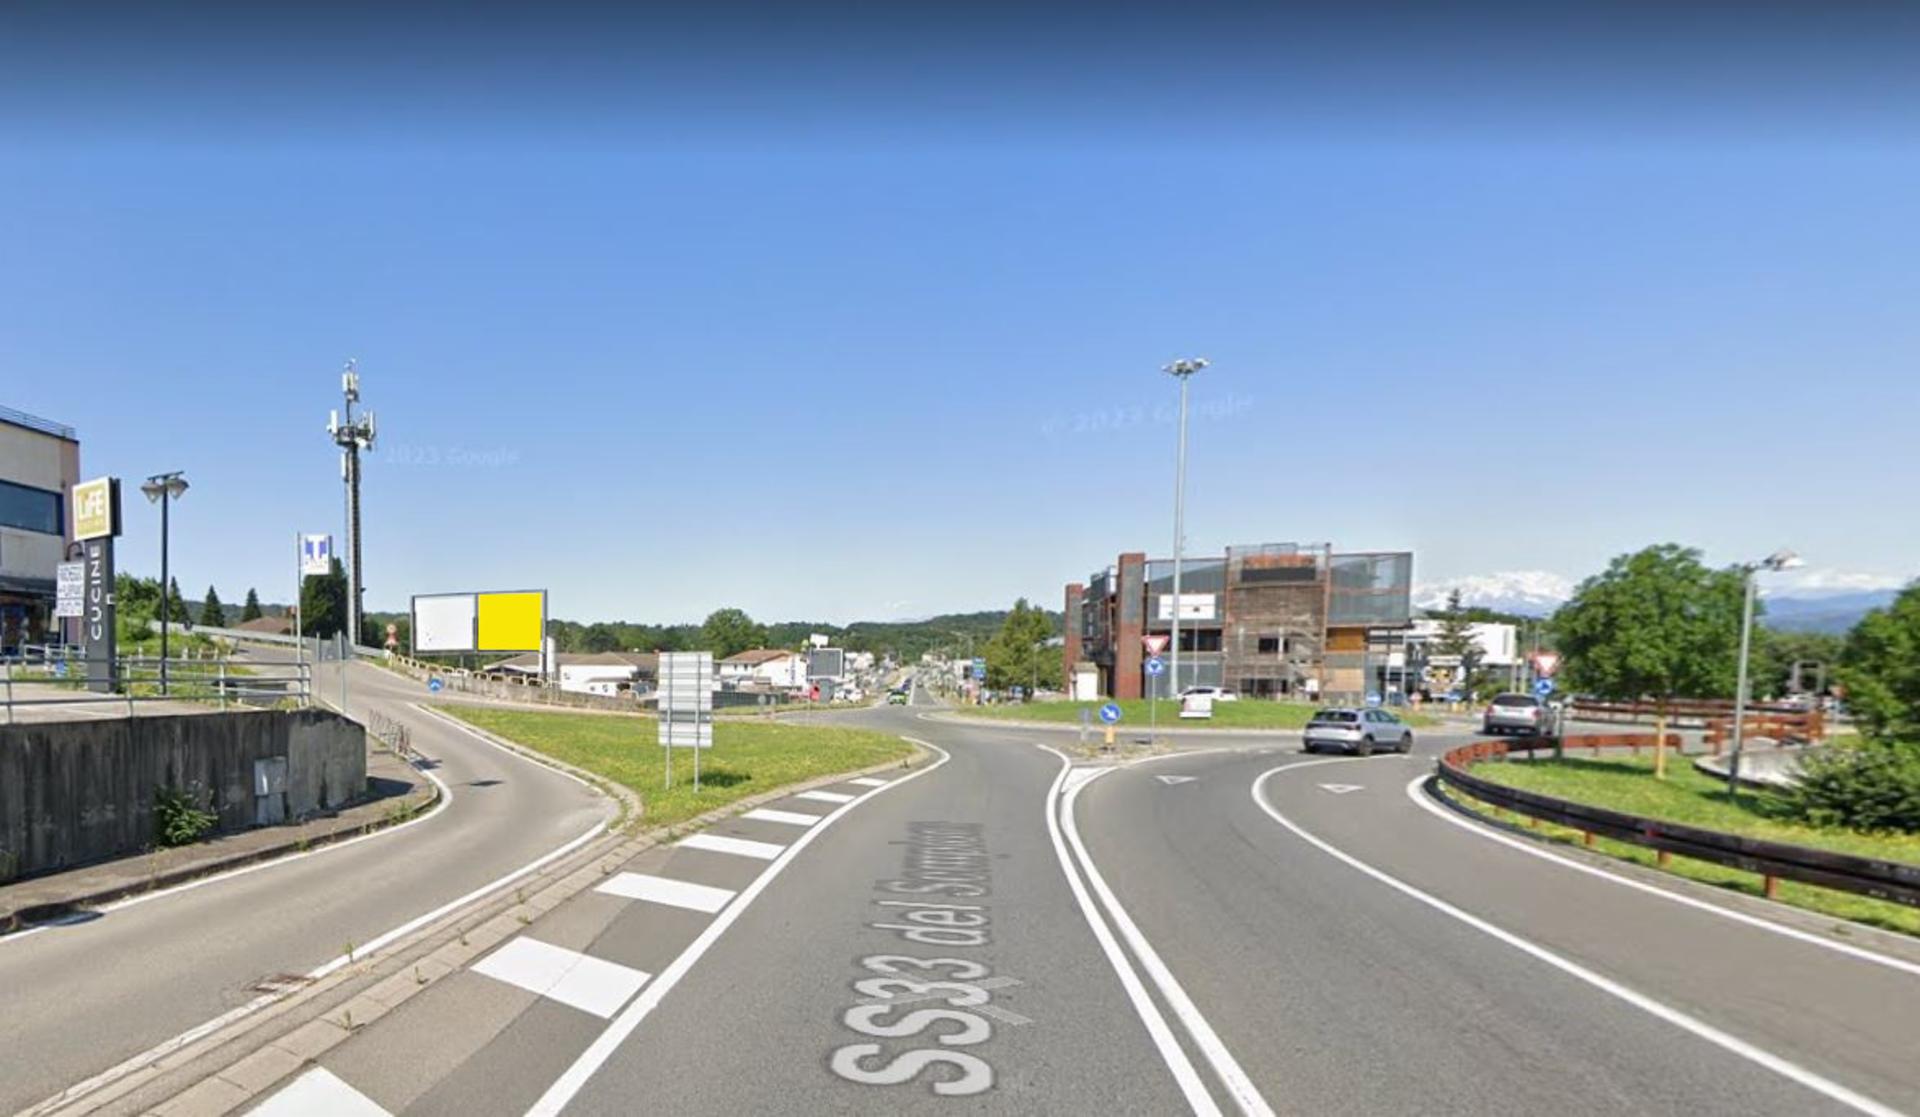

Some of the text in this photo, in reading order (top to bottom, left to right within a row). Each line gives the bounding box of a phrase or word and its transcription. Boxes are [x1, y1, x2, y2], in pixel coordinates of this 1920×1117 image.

[90, 546, 102, 640] CUCINE
[871, 901, 990, 946] del
[831, 954, 993, 1096] SS33
